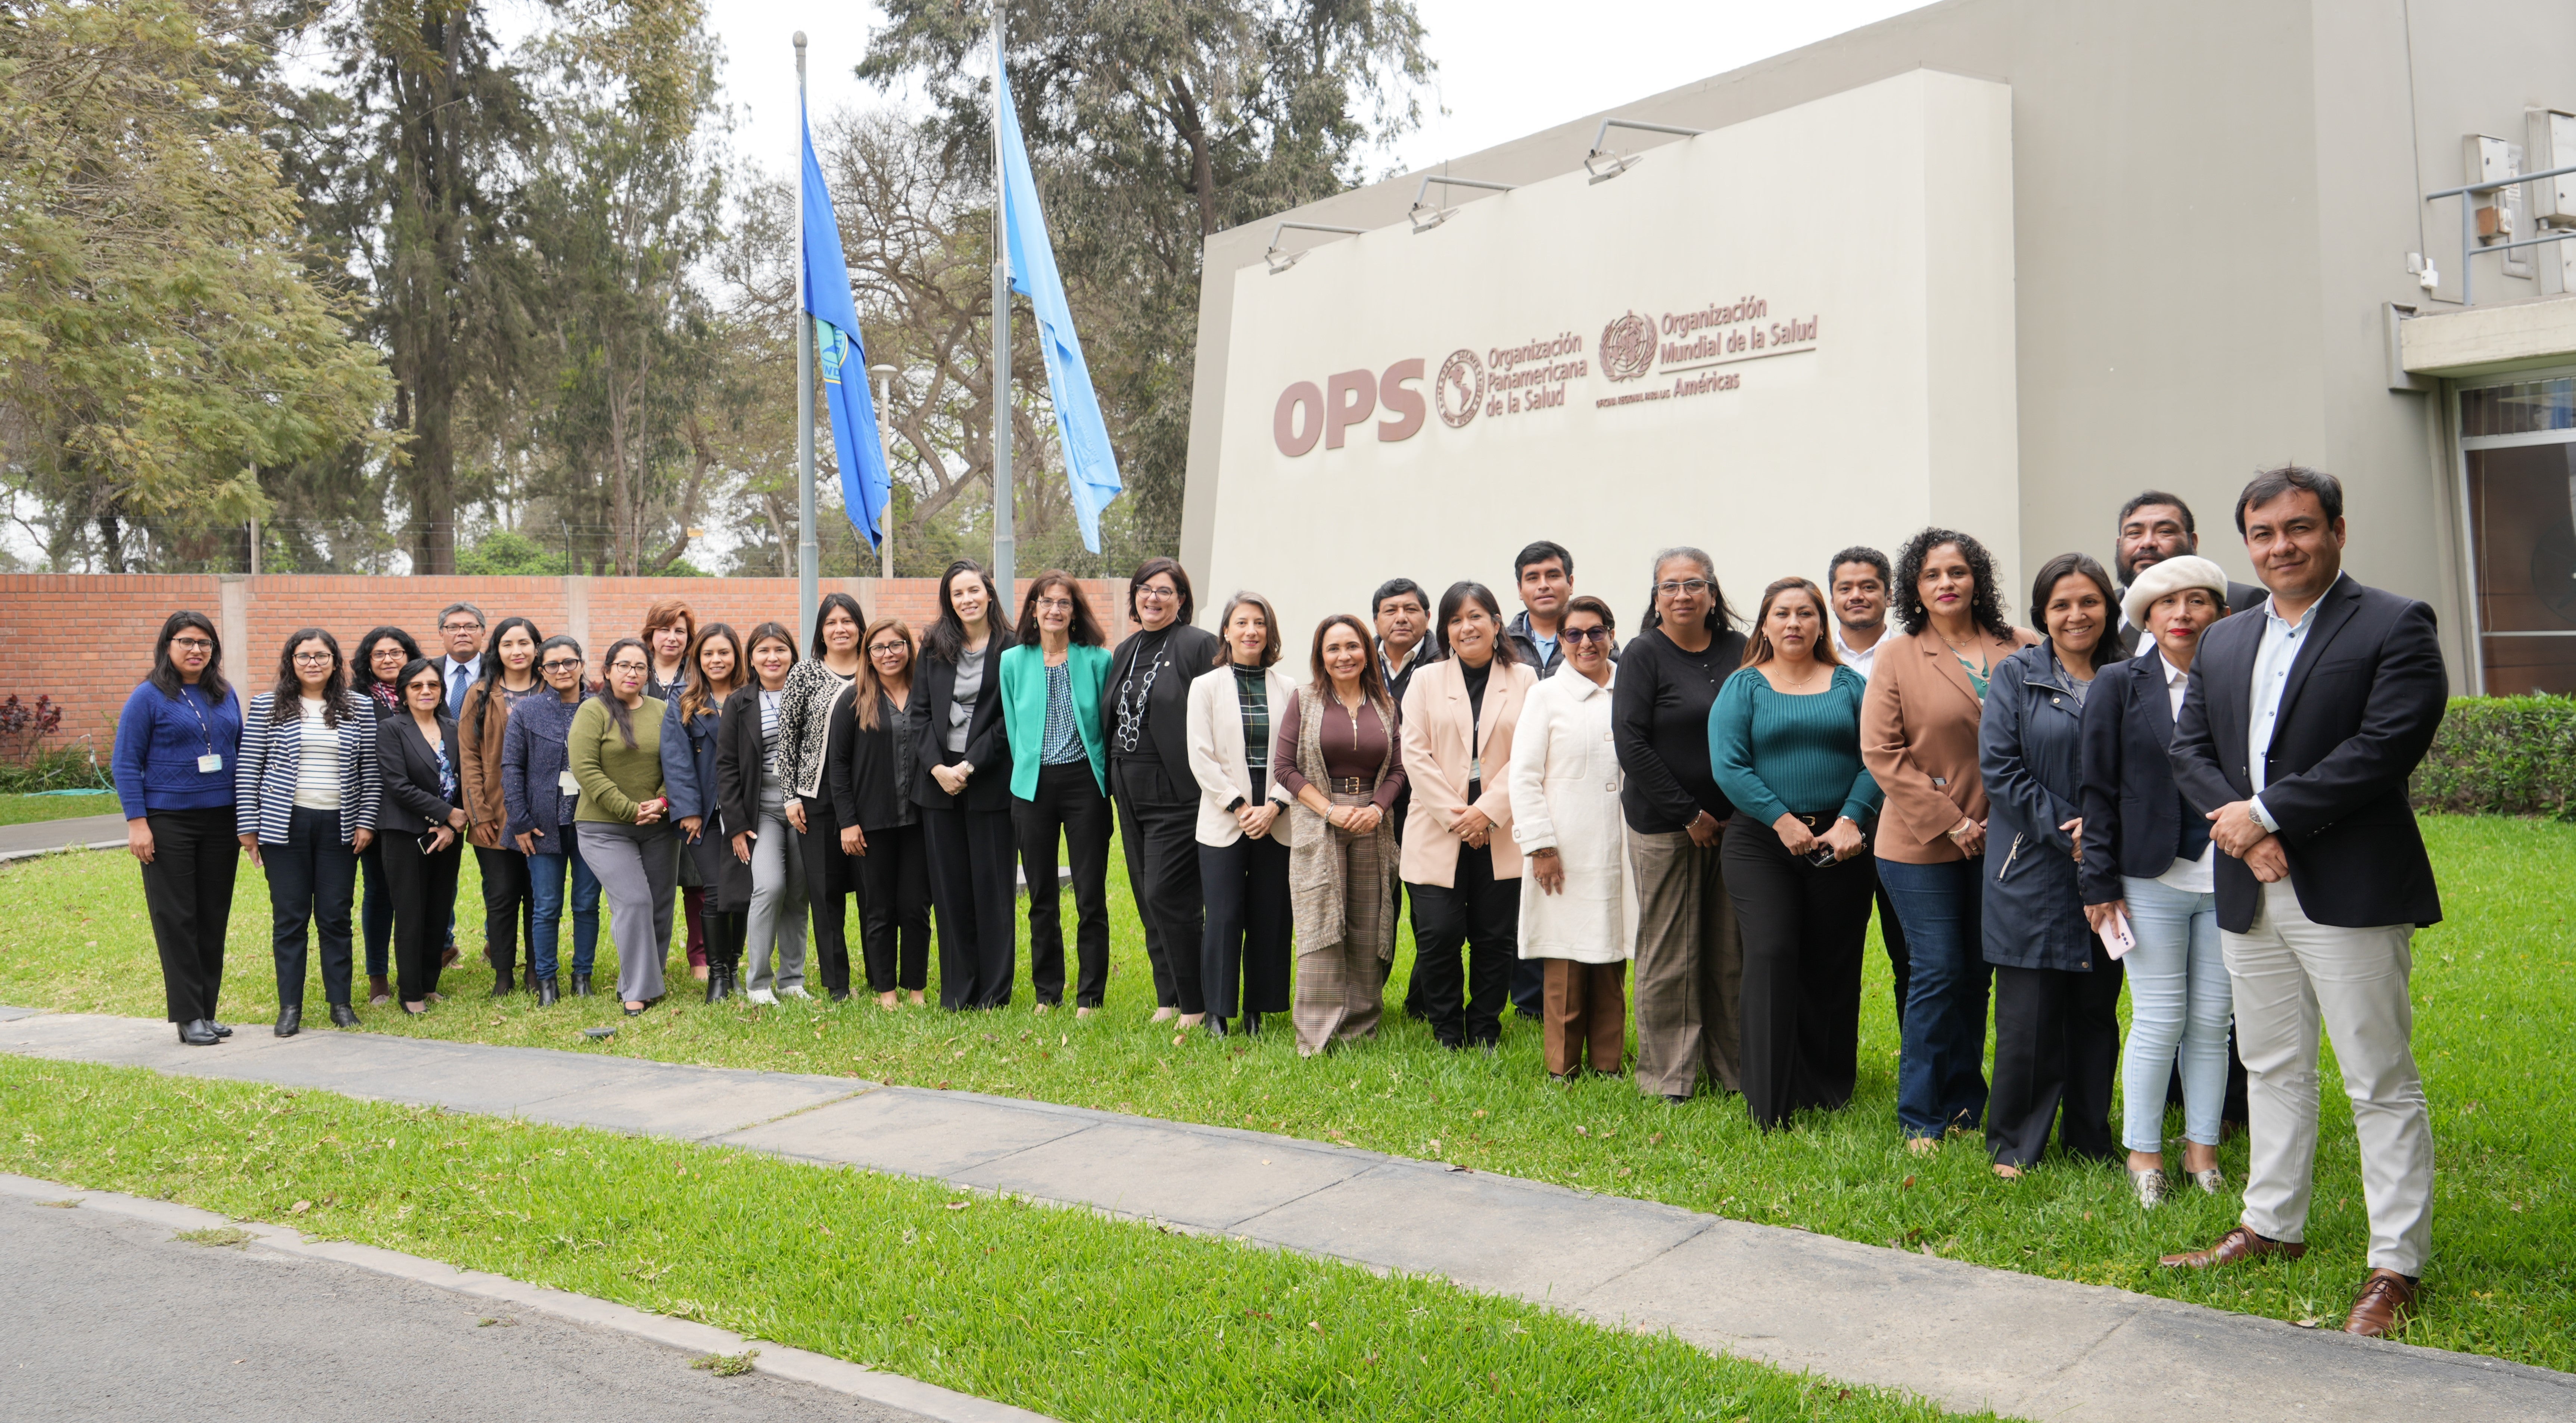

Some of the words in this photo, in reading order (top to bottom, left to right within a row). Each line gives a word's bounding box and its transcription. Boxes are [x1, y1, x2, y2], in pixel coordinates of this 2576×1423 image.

[1661, 296, 1767, 338] Organización
[1488, 331, 1582, 371] Organización
[1660, 332, 1721, 364] Mundial
[1727, 329, 1746, 352] de
[1751, 326, 1765, 349] la
[1770, 315, 1817, 346] Salud
[1488, 359, 1587, 393] Panamericana
[1673, 371, 1740, 397] Américas
[1274, 358, 1426, 457] OPS
[1486, 395, 1503, 417] de
[1508, 391, 1520, 413] la
[1525, 382, 1565, 411] Salud
